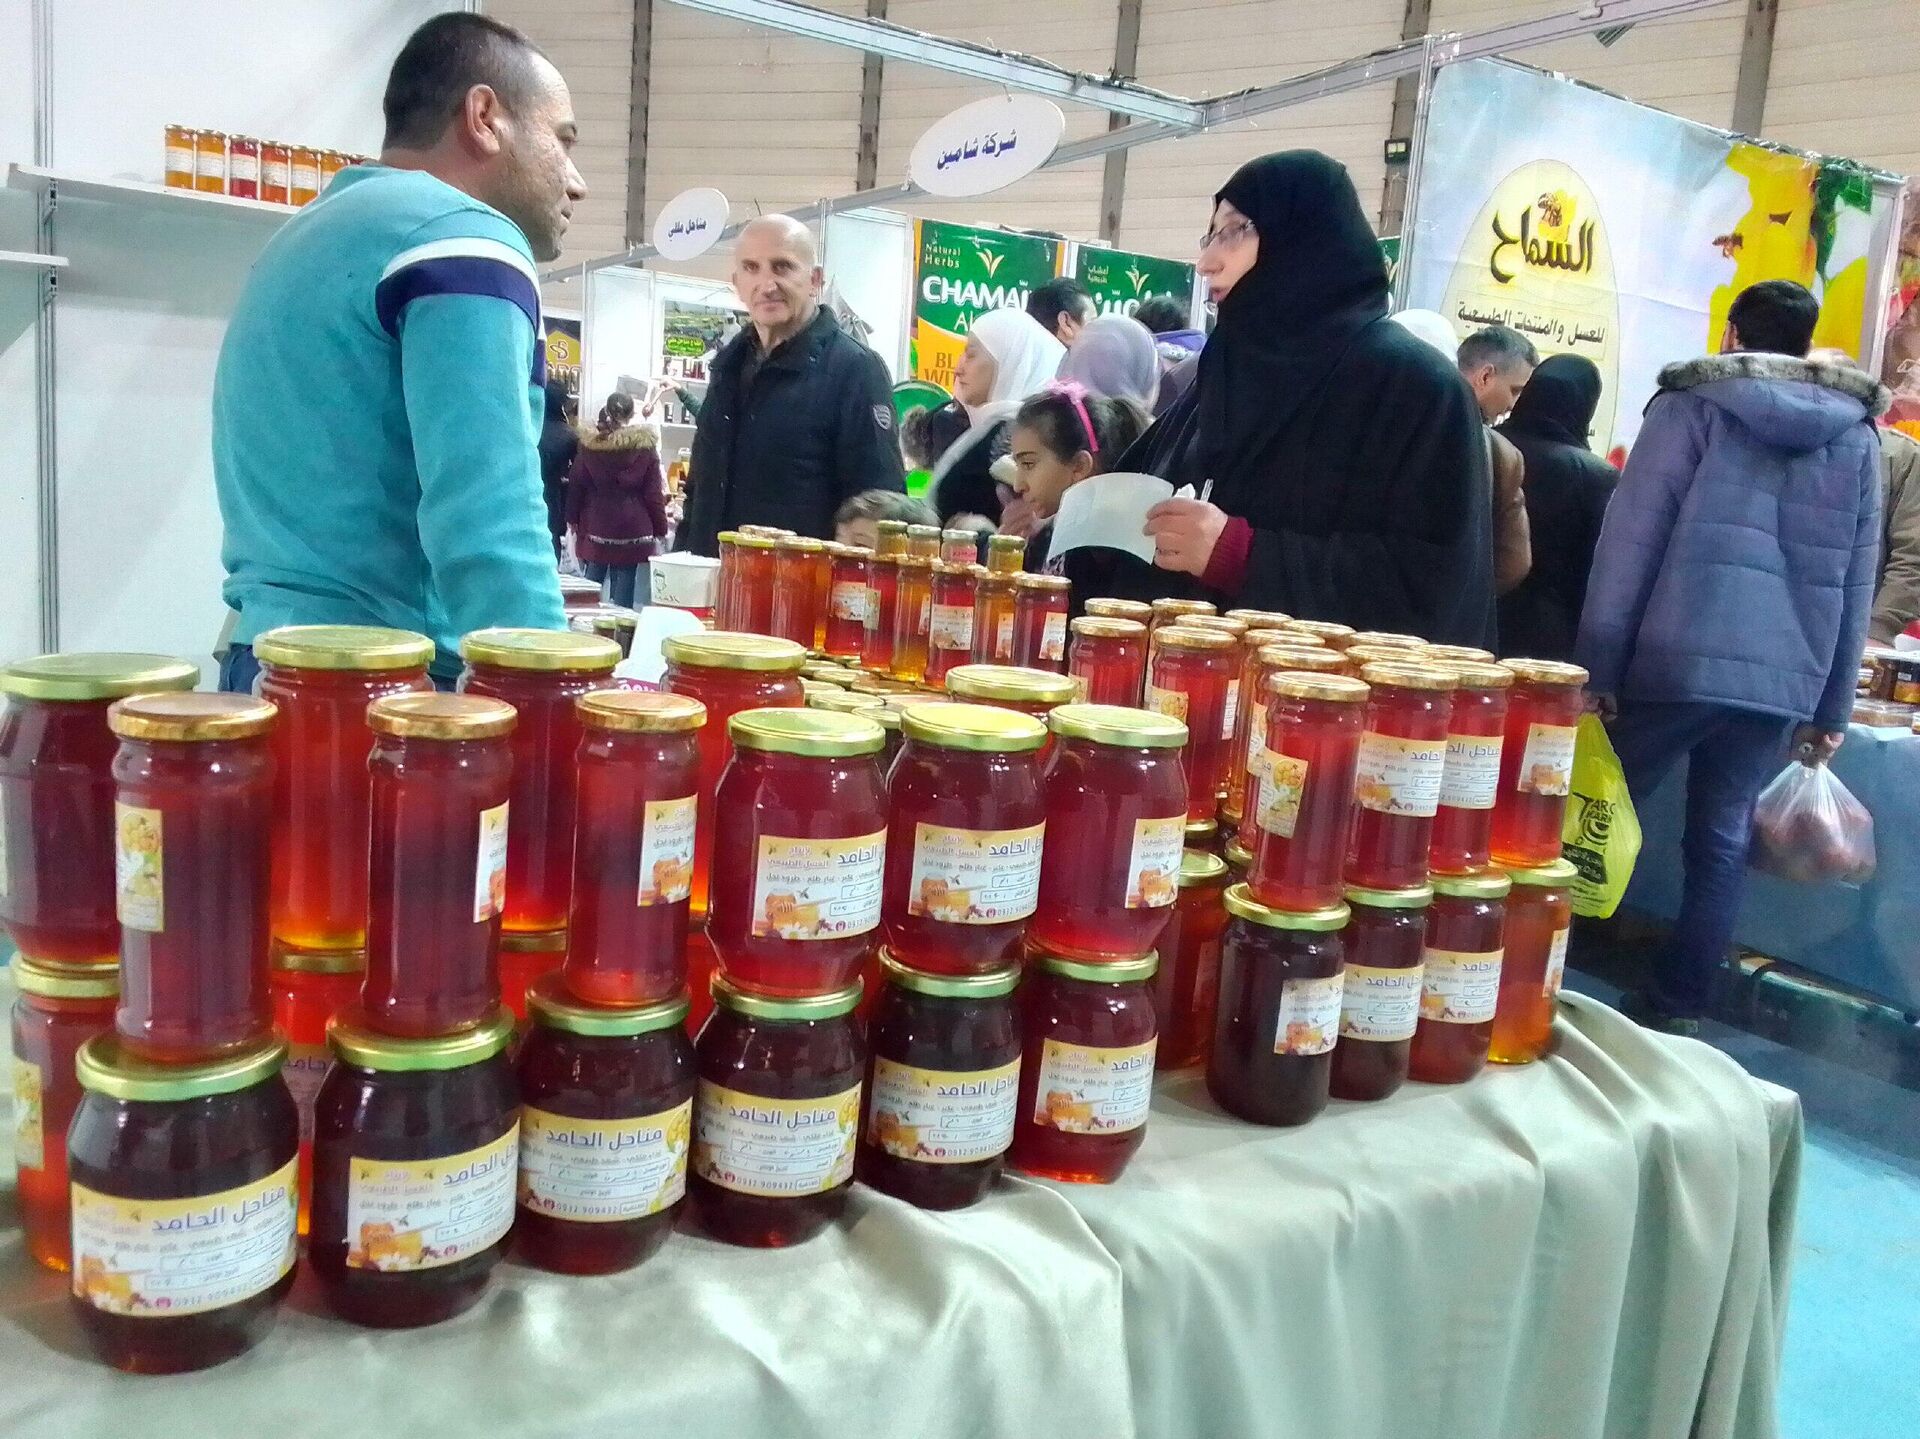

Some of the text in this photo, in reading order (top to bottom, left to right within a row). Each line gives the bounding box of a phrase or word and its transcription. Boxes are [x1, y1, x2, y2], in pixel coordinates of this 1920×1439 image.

[937, 129, 1017, 170] شركة شامين
[685, 216, 707, 235] مناحل
[925, 243, 961, 256] Natural
[1490, 205, 1595, 284] السماح
[924, 255, 960, 269] Herbs
[1568, 322, 1606, 346] للعسل
[838, 845, 878, 865] الحامد
[989, 838, 1031, 856] الحامد
[937, 1081, 987, 1096] الحامد
[729, 1106, 836, 1129] مناحل الحامد
[545, 1127, 663, 1151] مناحل الحامد
[442, 1154, 498, 1186] الحامد
[233, 1185, 286, 1224] مناحل
[152, 1206, 225, 1232] الحامد
